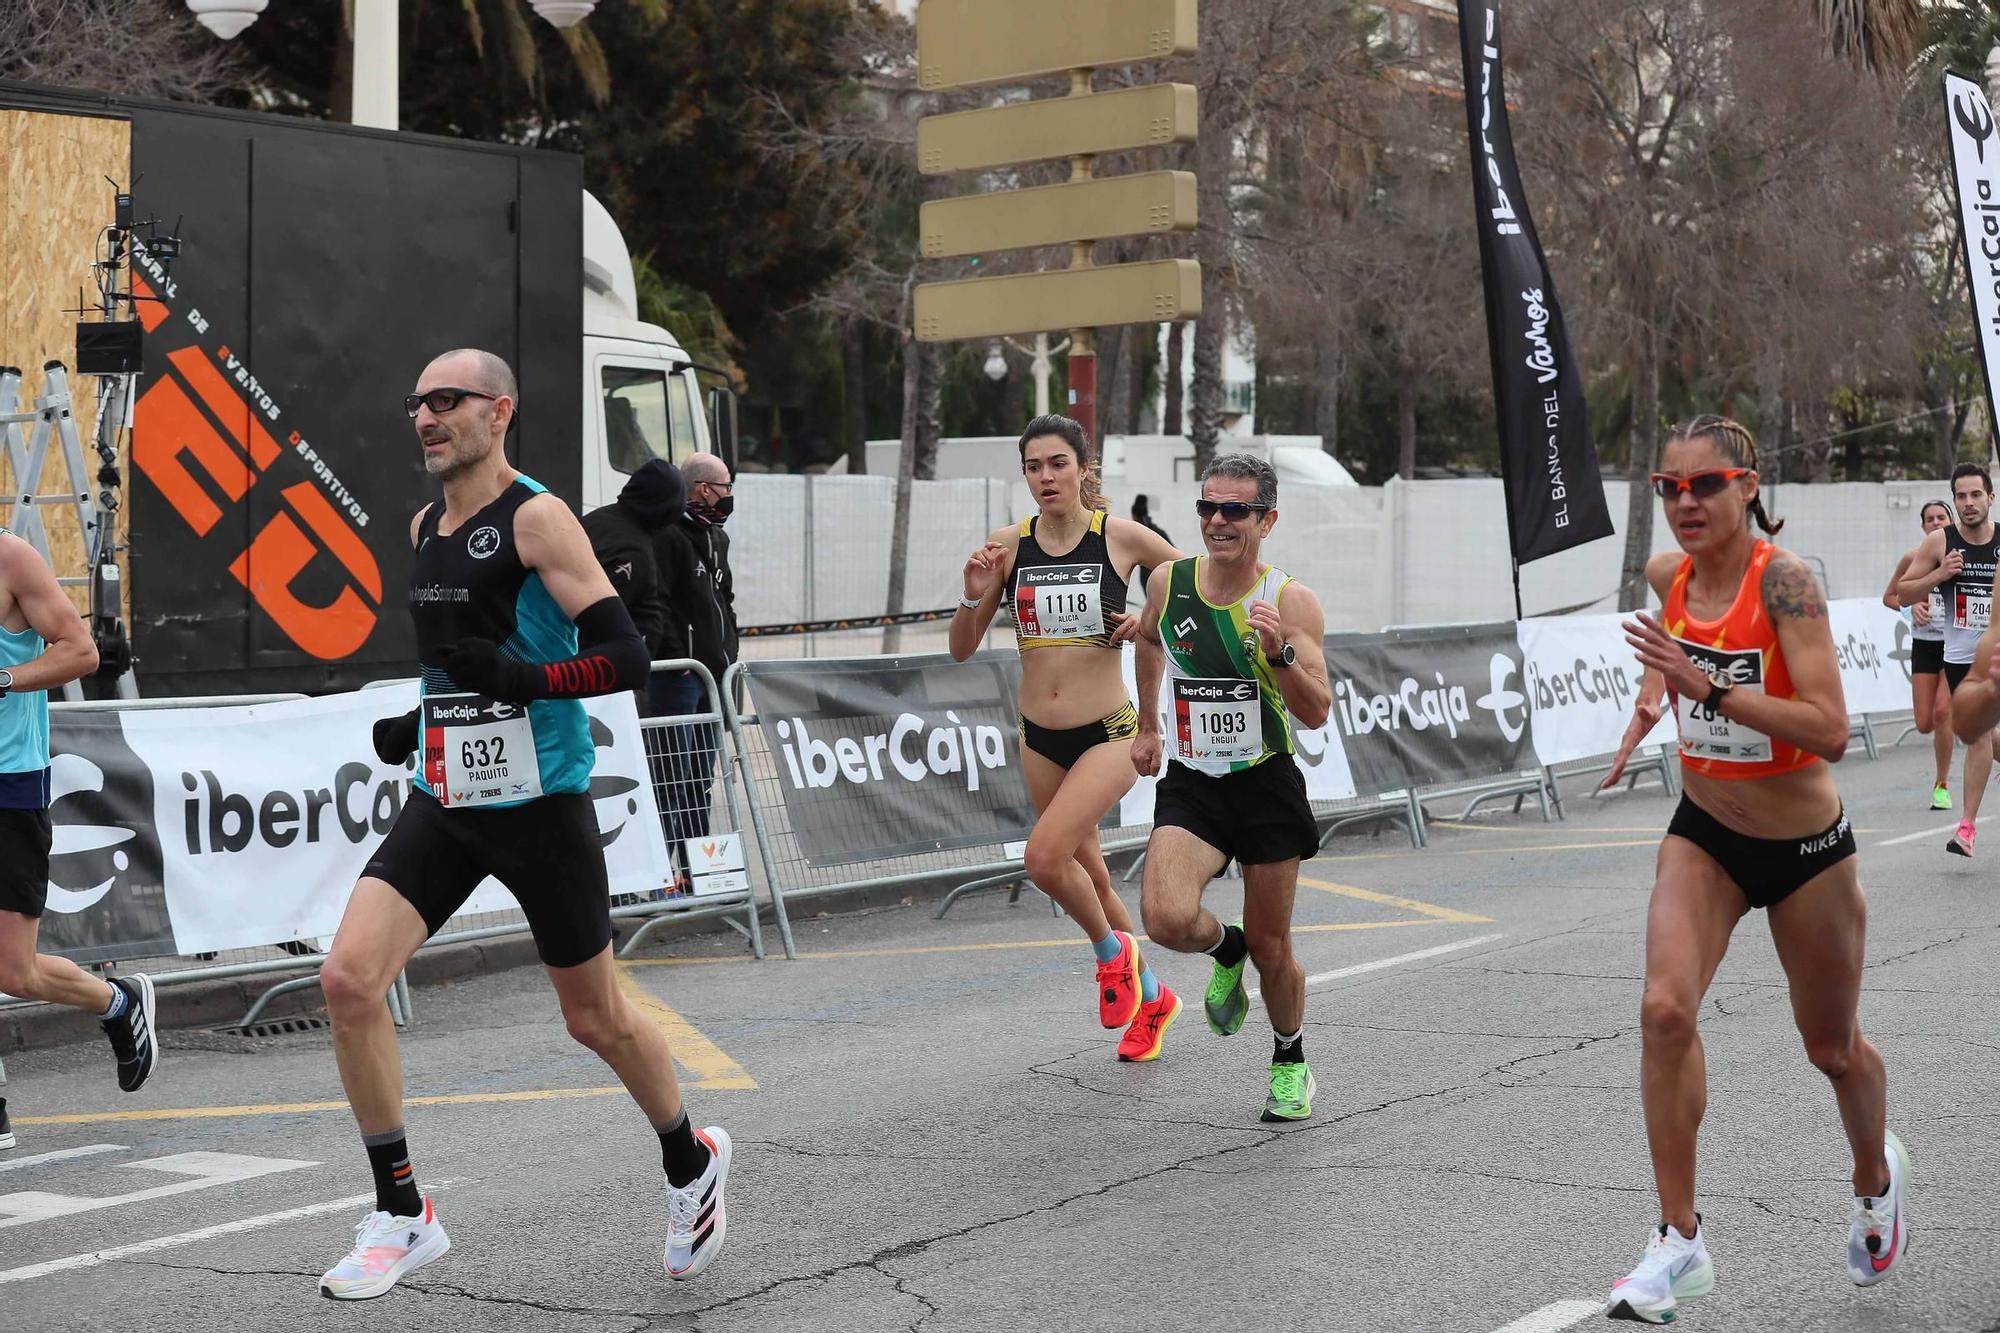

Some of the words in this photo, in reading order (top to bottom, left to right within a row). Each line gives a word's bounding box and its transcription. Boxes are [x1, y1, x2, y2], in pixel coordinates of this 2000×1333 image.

[1974, 179, 2000, 336] rCaja
[1521, 287, 1558, 384] Vamos
[186, 308, 210, 335] DE
[217, 345, 281, 421] EVENTOS
[288, 430, 371, 528] DEPORTIVOS
[1555, 502, 1570, 529] EL
[1027, 572, 1069, 582] iberCaja
[1045, 593, 1087, 614] 1118
[1972, 602, 1992, 615] 204
[1026, 621, 1037, 631] 01
[1058, 614, 1080, 623] ALICIA
[1688, 654, 1717, 673] Caja
[1835, 630, 1882, 680] erCaja
[1179, 684, 1223, 699] iberCaja
[1528, 655, 1631, 712] iberCaja
[433, 704, 478, 721] iberCaja
[1335, 672, 1471, 739] iberCaja
[1199, 711, 1246, 734] 1093
[1709, 726, 1729, 737] LISA
[777, 709, 1007, 792] iberCaja
[1211, 735, 1238, 744] ENGUIX
[461, 736, 508, 769] 632
[468, 767, 509, 782] PAQUITO
[433, 782, 444, 798] 01
[181, 758, 415, 855] iberCa
[1800, 830, 1838, 856] NIKE
